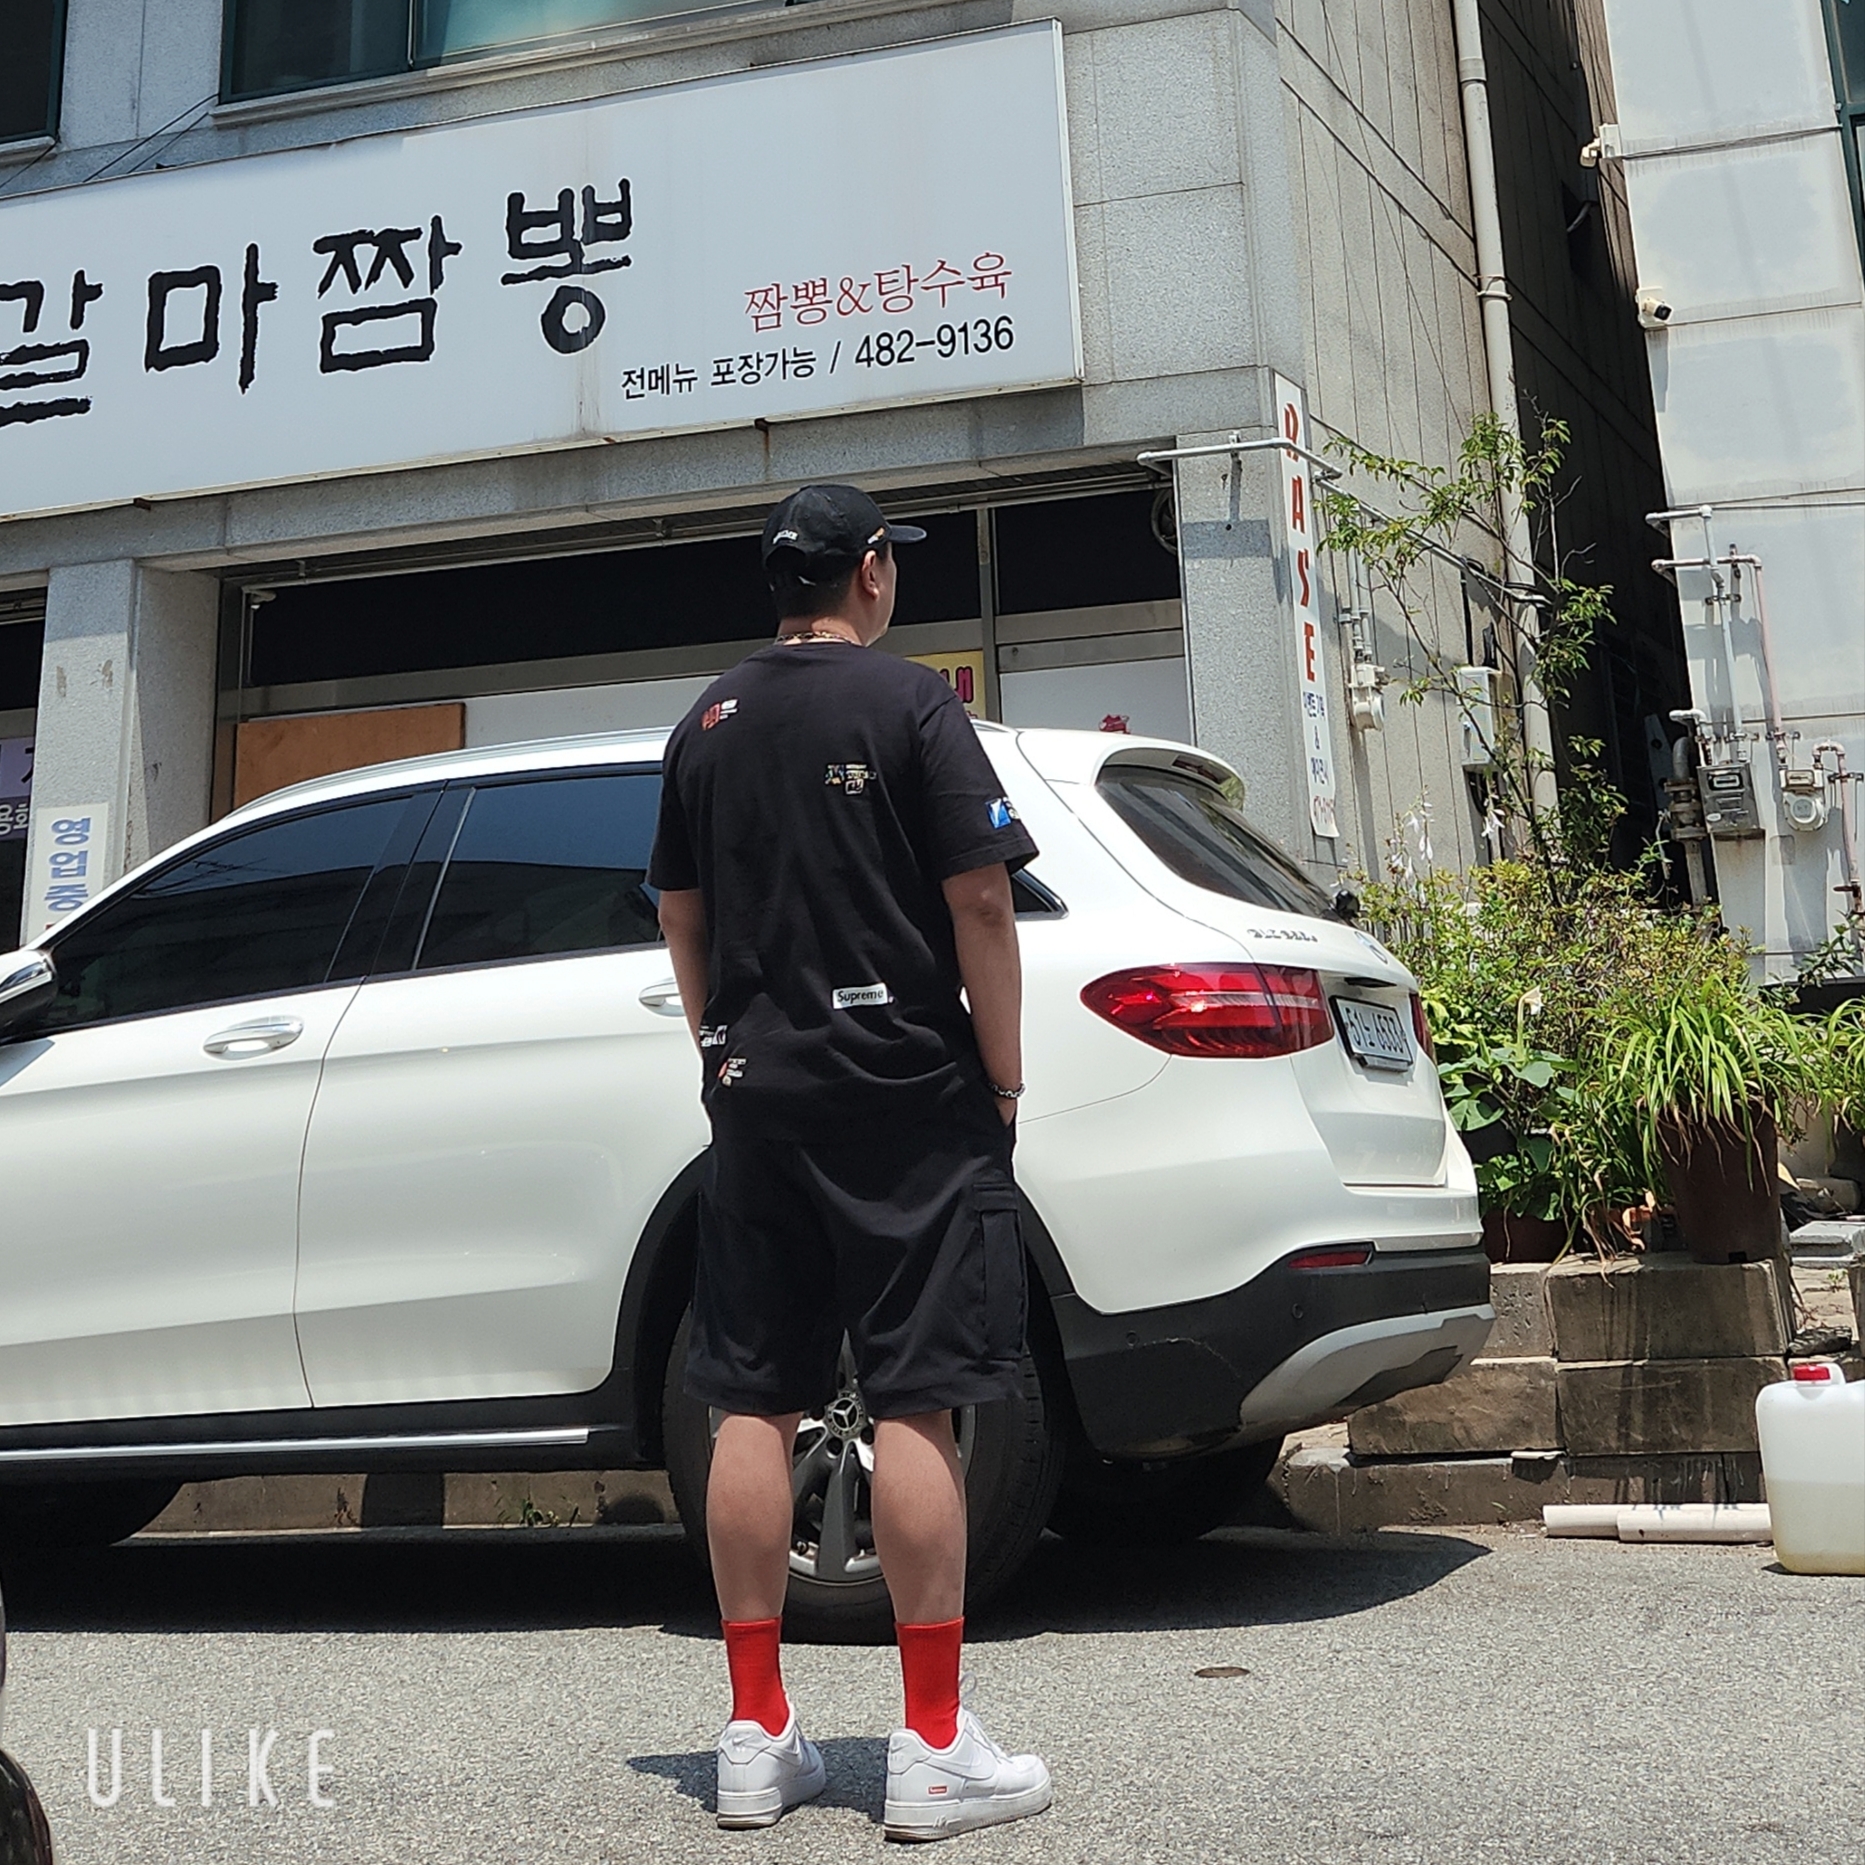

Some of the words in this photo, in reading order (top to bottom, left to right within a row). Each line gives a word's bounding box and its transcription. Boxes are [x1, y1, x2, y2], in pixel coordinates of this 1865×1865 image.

[744, 251, 1012, 333] 짬뽕&탕수육
[621, 364, 698, 399] 전메뉴
[710, 346, 817, 387] 포장가능
[829, 341, 842, 374] /
[855, 315, 1014, 368] 482-9136
[837, 989, 884, 1004] Supreme
